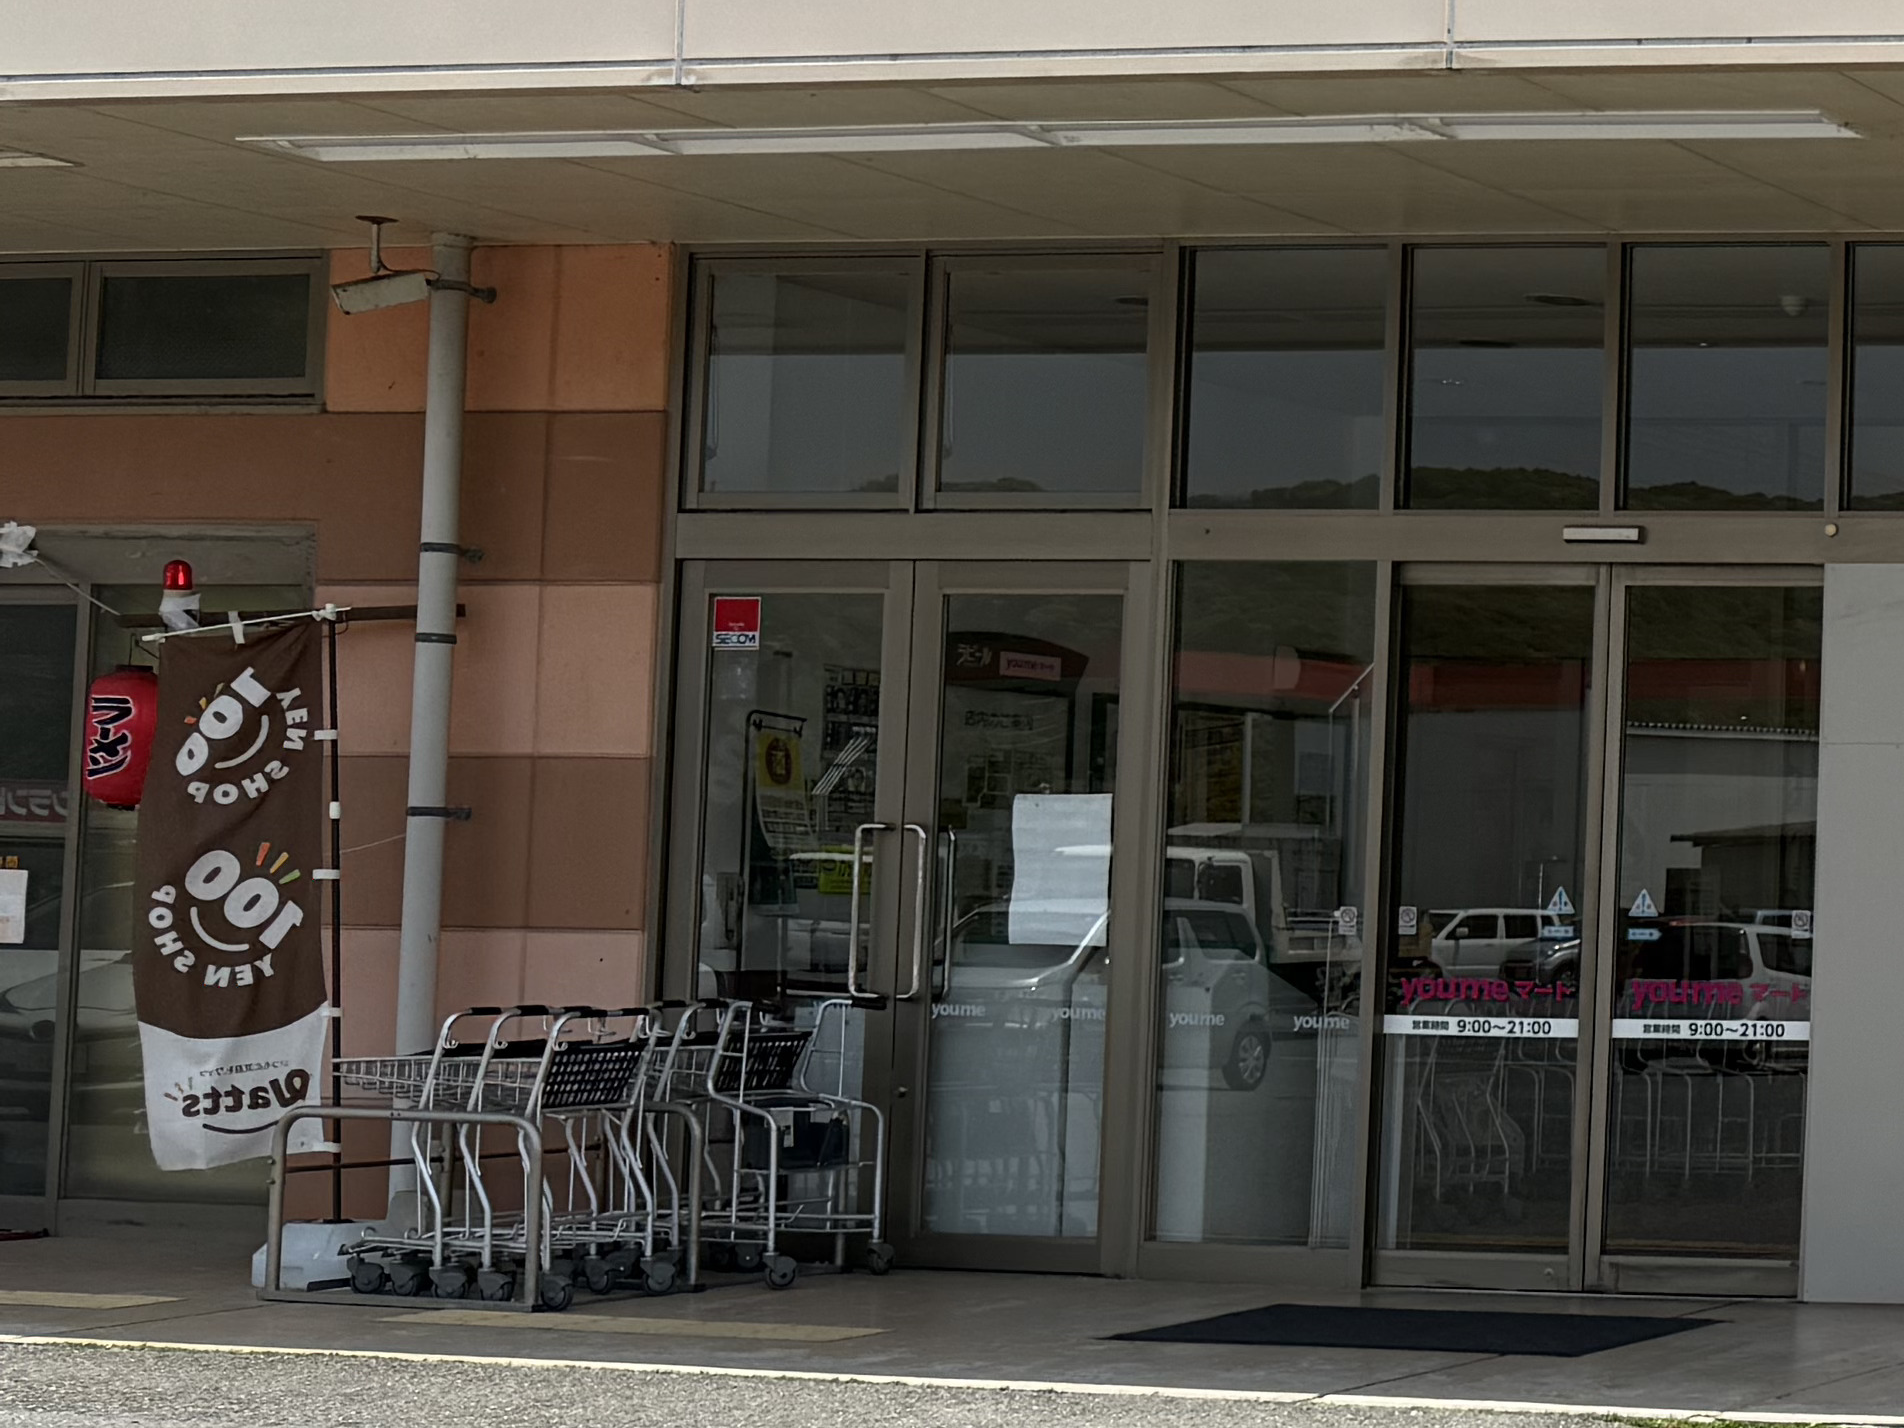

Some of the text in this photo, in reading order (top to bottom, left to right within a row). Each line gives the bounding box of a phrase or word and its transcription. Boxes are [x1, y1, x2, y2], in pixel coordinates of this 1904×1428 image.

[715, 633, 756, 644] SECOM
[1400, 976, 1510, 1006] youme
[1631, 979, 1744, 1011] youme
[931, 1002, 986, 1020] youme
[1169, 1012, 1225, 1028] youme
[1292, 1014, 1350, 1032] youme
